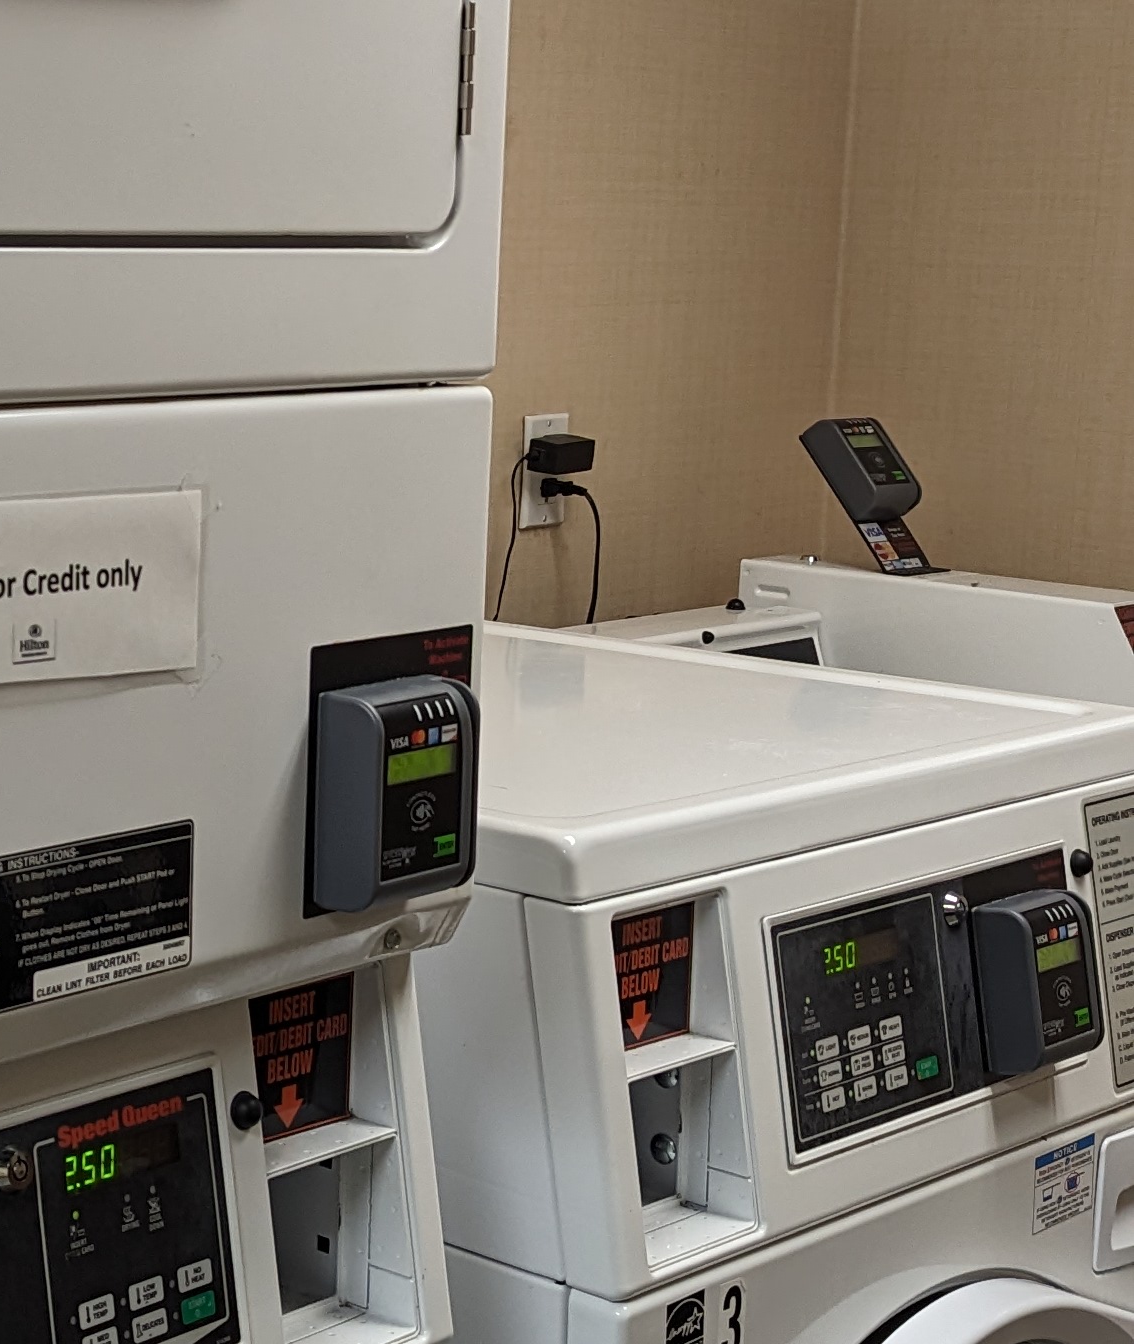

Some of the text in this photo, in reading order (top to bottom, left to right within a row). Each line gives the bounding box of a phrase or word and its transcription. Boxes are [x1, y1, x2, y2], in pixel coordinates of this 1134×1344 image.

[23, 563, 90, 596] Credit
[96, 558, 143, 592] only
[19, 639, 50, 652] Hilton
[390, 735, 409, 750] VISA
[622, 916, 662, 946] INSERT
[616, 937, 689, 974] IT/DEBIT CARD
[36, 953, 186, 998] CLEAN LINT FILTER BEFORE EACH LOAD
[621, 967, 661, 999] BELOW
[269, 990, 316, 1025] INSERT
[253, 1013, 348, 1057] DIT/DEBIT CARD
[267, 1048, 313, 1084] BELOW
[57, 1096, 183, 1149] Speed Queen
[65, 1144, 114, 1191] 2.50
[1053, 1142, 1078, 1159] NOTICE
[143, 1283, 156, 1293] LOW
